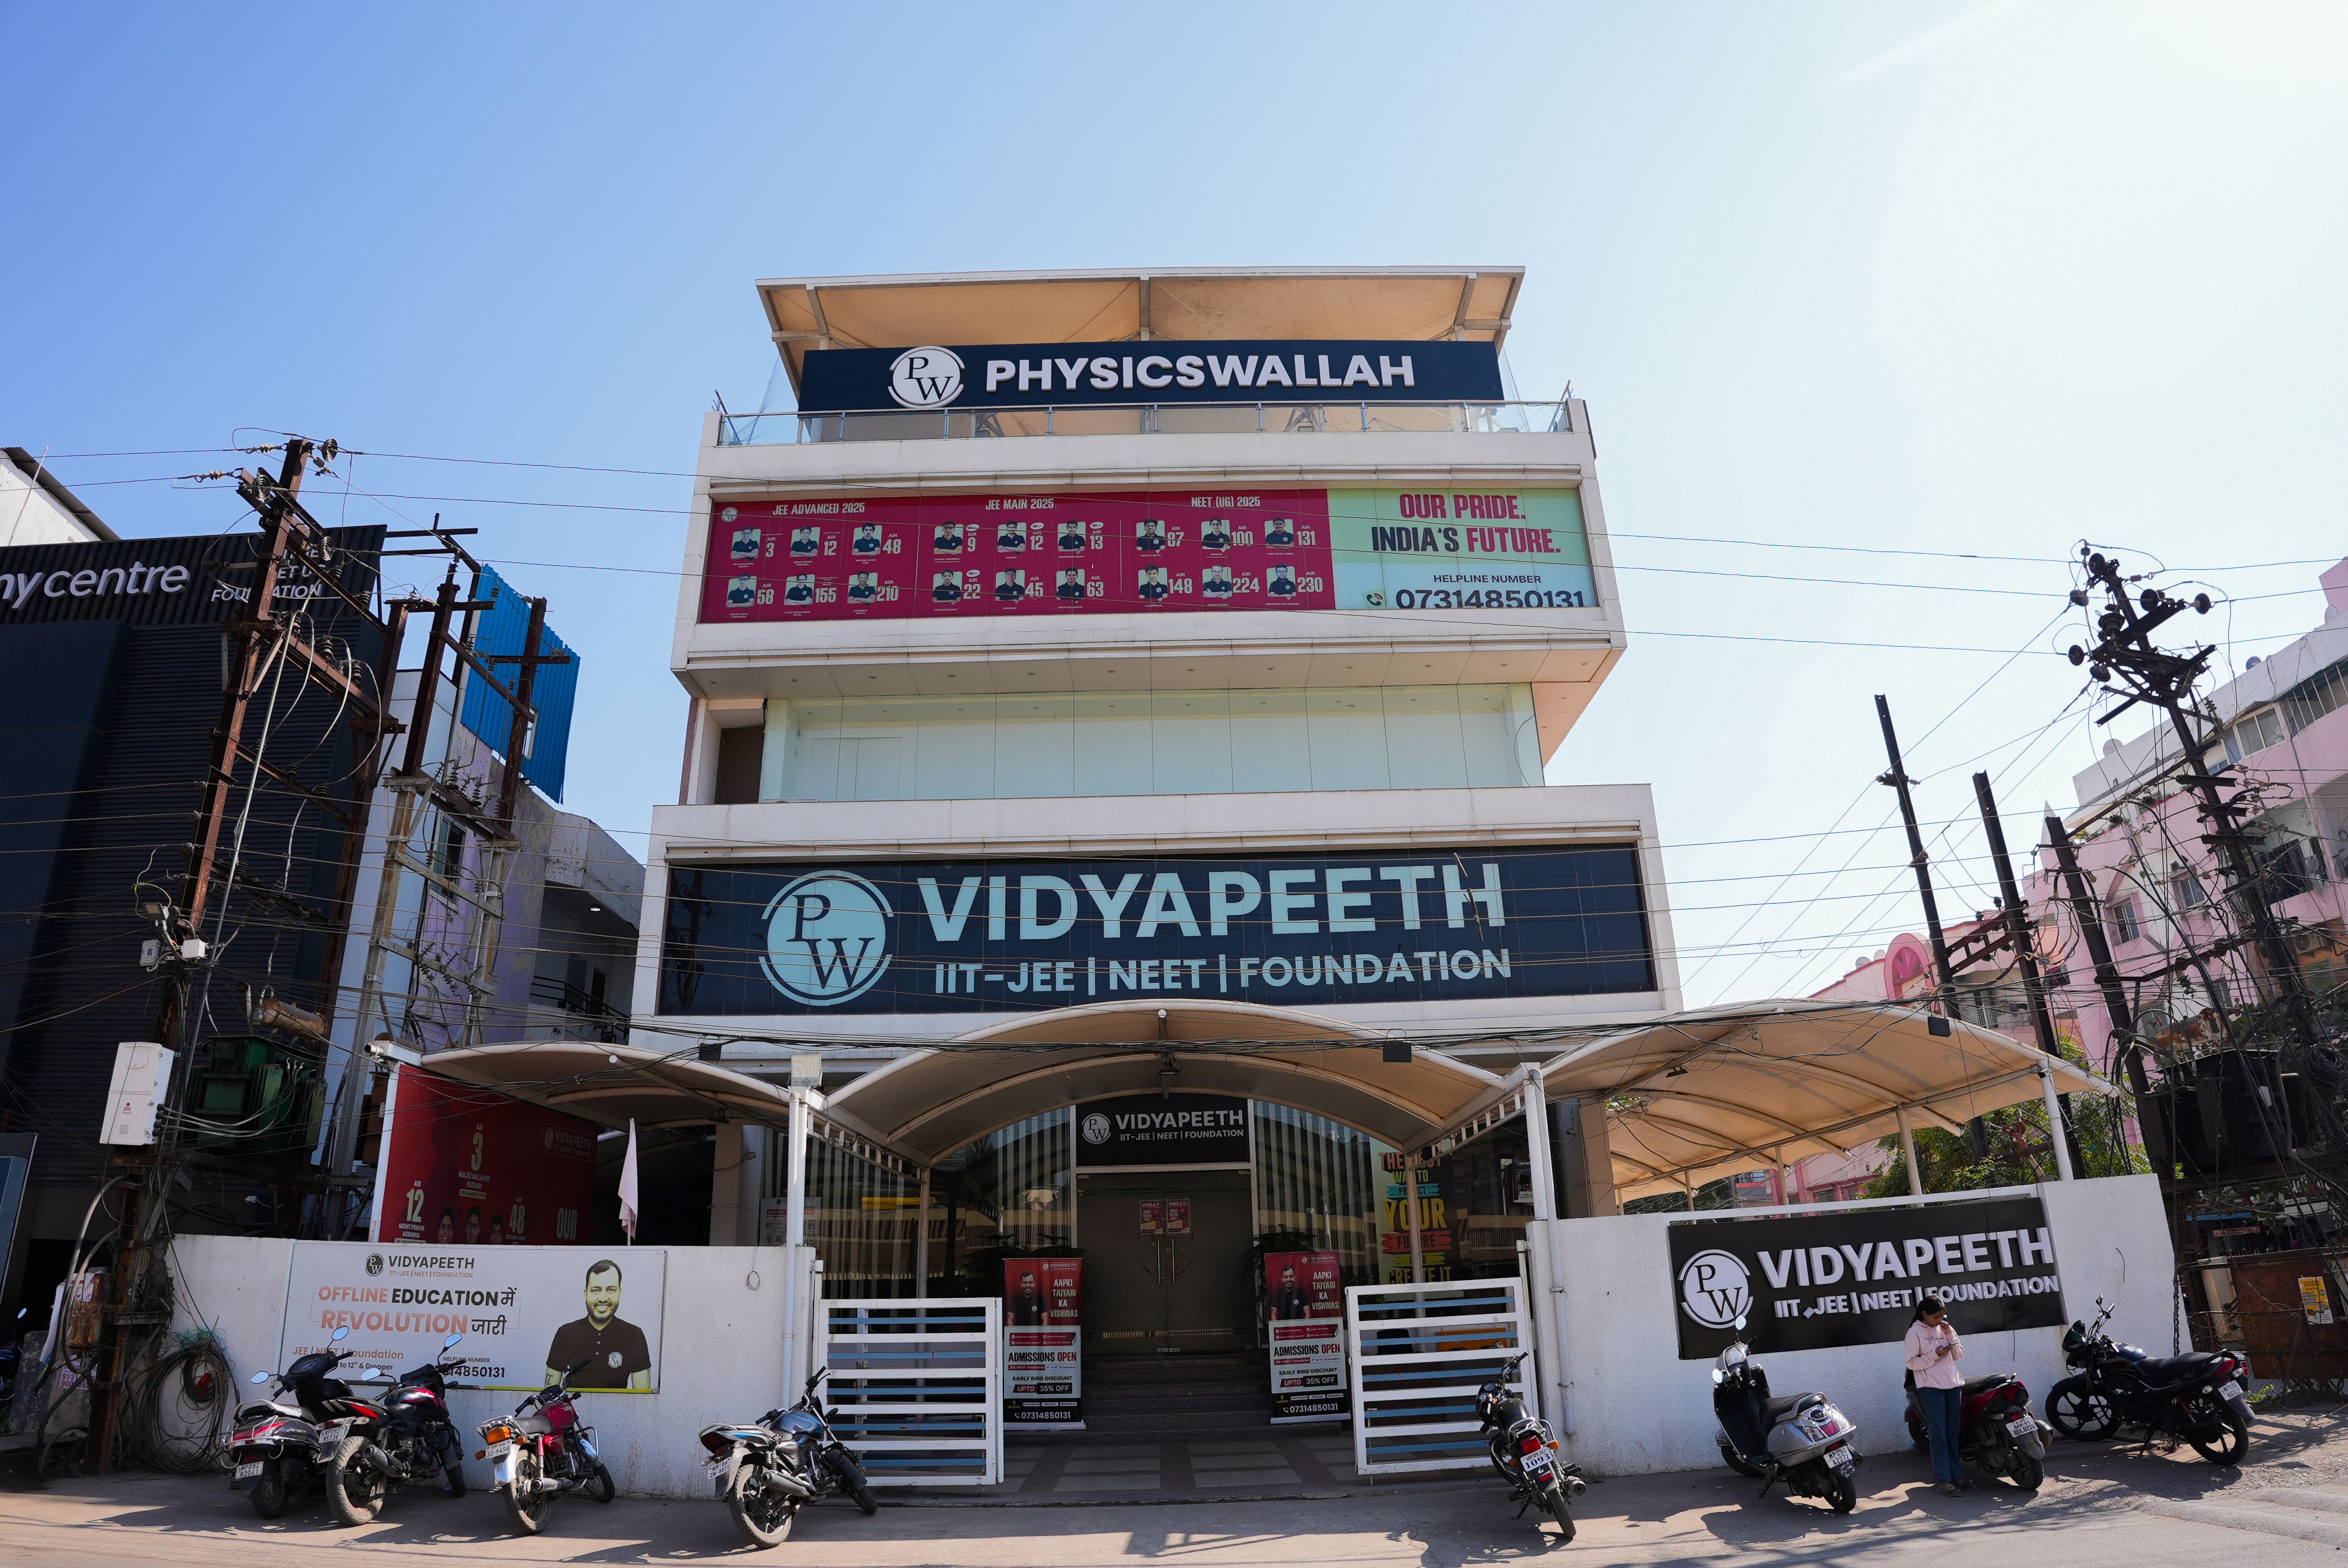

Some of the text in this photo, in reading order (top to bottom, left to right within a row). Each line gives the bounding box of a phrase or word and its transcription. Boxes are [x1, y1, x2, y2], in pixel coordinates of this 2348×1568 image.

[986, 354, 1415, 393] PHYSICSWALLAH
[773, 502, 865, 515] JEE ADVANCED 2025
[986, 498, 1054, 510] JEE MAIN 2025
[1191, 496, 1260, 508] NEET (UG) 2025
[1399, 494, 1526, 519] OUR PRIDE.
[967, 537, 976, 552] 9
[1030, 535, 1044, 550] 12
[1090, 535, 1103, 550] 13
[1232, 531, 1253, 546] 100
[1297, 531, 1316, 545] 131
[1466, 528, 1561, 553] FUTURE.
[765, 543, 775, 558] 3
[823, 540, 837, 556] 12
[882, 539, 901, 554] 48
[1168, 578, 1192, 594] 148
[1233, 577, 1260, 593] 224
[1297, 577, 1323, 592] 230
[1434, 575, 1542, 584] HELPLINE NUMBER
[815, 587, 837, 603] 155
[877, 586, 899, 601] 210
[964, 584, 981, 599] 22
[1024, 582, 1044, 598] 45
[1087, 581, 1104, 597] 63
[757, 589, 775, 605] 58
[1396, 590, 1584, 608] 07314850131
[917, 863, 1505, 942] VIDYAPEETH
[935, 948, 1512, 994] IIT-JEE NEET FOUNDATION
[1115, 1110, 1244, 1130] VIDYAPEETH
[554, 1130, 592, 1151] VIDYAPEETH
[1120, 1129, 1244, 1141] IIT-JEE NEET FOUNDATION
[471, 1132, 483, 1172] 3
[1378, 1152, 1404, 1170] THE
[1417, 1170, 1429, 1182] TO
[406, 1188, 425, 1223] 12
[508, 1204, 526, 1235] 48
[556, 1207, 578, 1240] OUR
[389, 1256, 475, 1270] VIDYAPEETH
[1756, 1227, 2054, 1288] VIDYAPEETH
[1054, 1278, 1073, 1287] AAPKI
[1313, 1271, 1332, 1280] AAPKI
[1052, 1288, 1076, 1297] TAIYARI
[1312, 1281, 1336, 1290] TAIYARI
[1861, 1288, 1912, 1311] NEET
[1924, 1275, 2059, 1304] FOUNDATION
[318, 1286, 389, 1303] OFFLINE
[392, 1288, 498, 1307] EDUCATION
[1319, 1292, 1328, 1300] KA
[1050, 1309, 1078, 1318] VISHWAS
[1311, 1301, 1339, 1311] VISHWAS
[321, 1310, 468, 1334] REVOLUTION
[292, 1346, 308, 1355] JEE
[1008, 1352, 1077, 1362] ADMISSIONS OPEN
[1274, 1343, 1341, 1356] ADMISSIONS OPEN
[1290, 1403, 1338, 1413] 07314850131
[1829, 1447, 1846, 1459] MP09U
[1832, 1454, 1850, 1466] A2272
[1525, 1453, 1550, 1469] 1093
